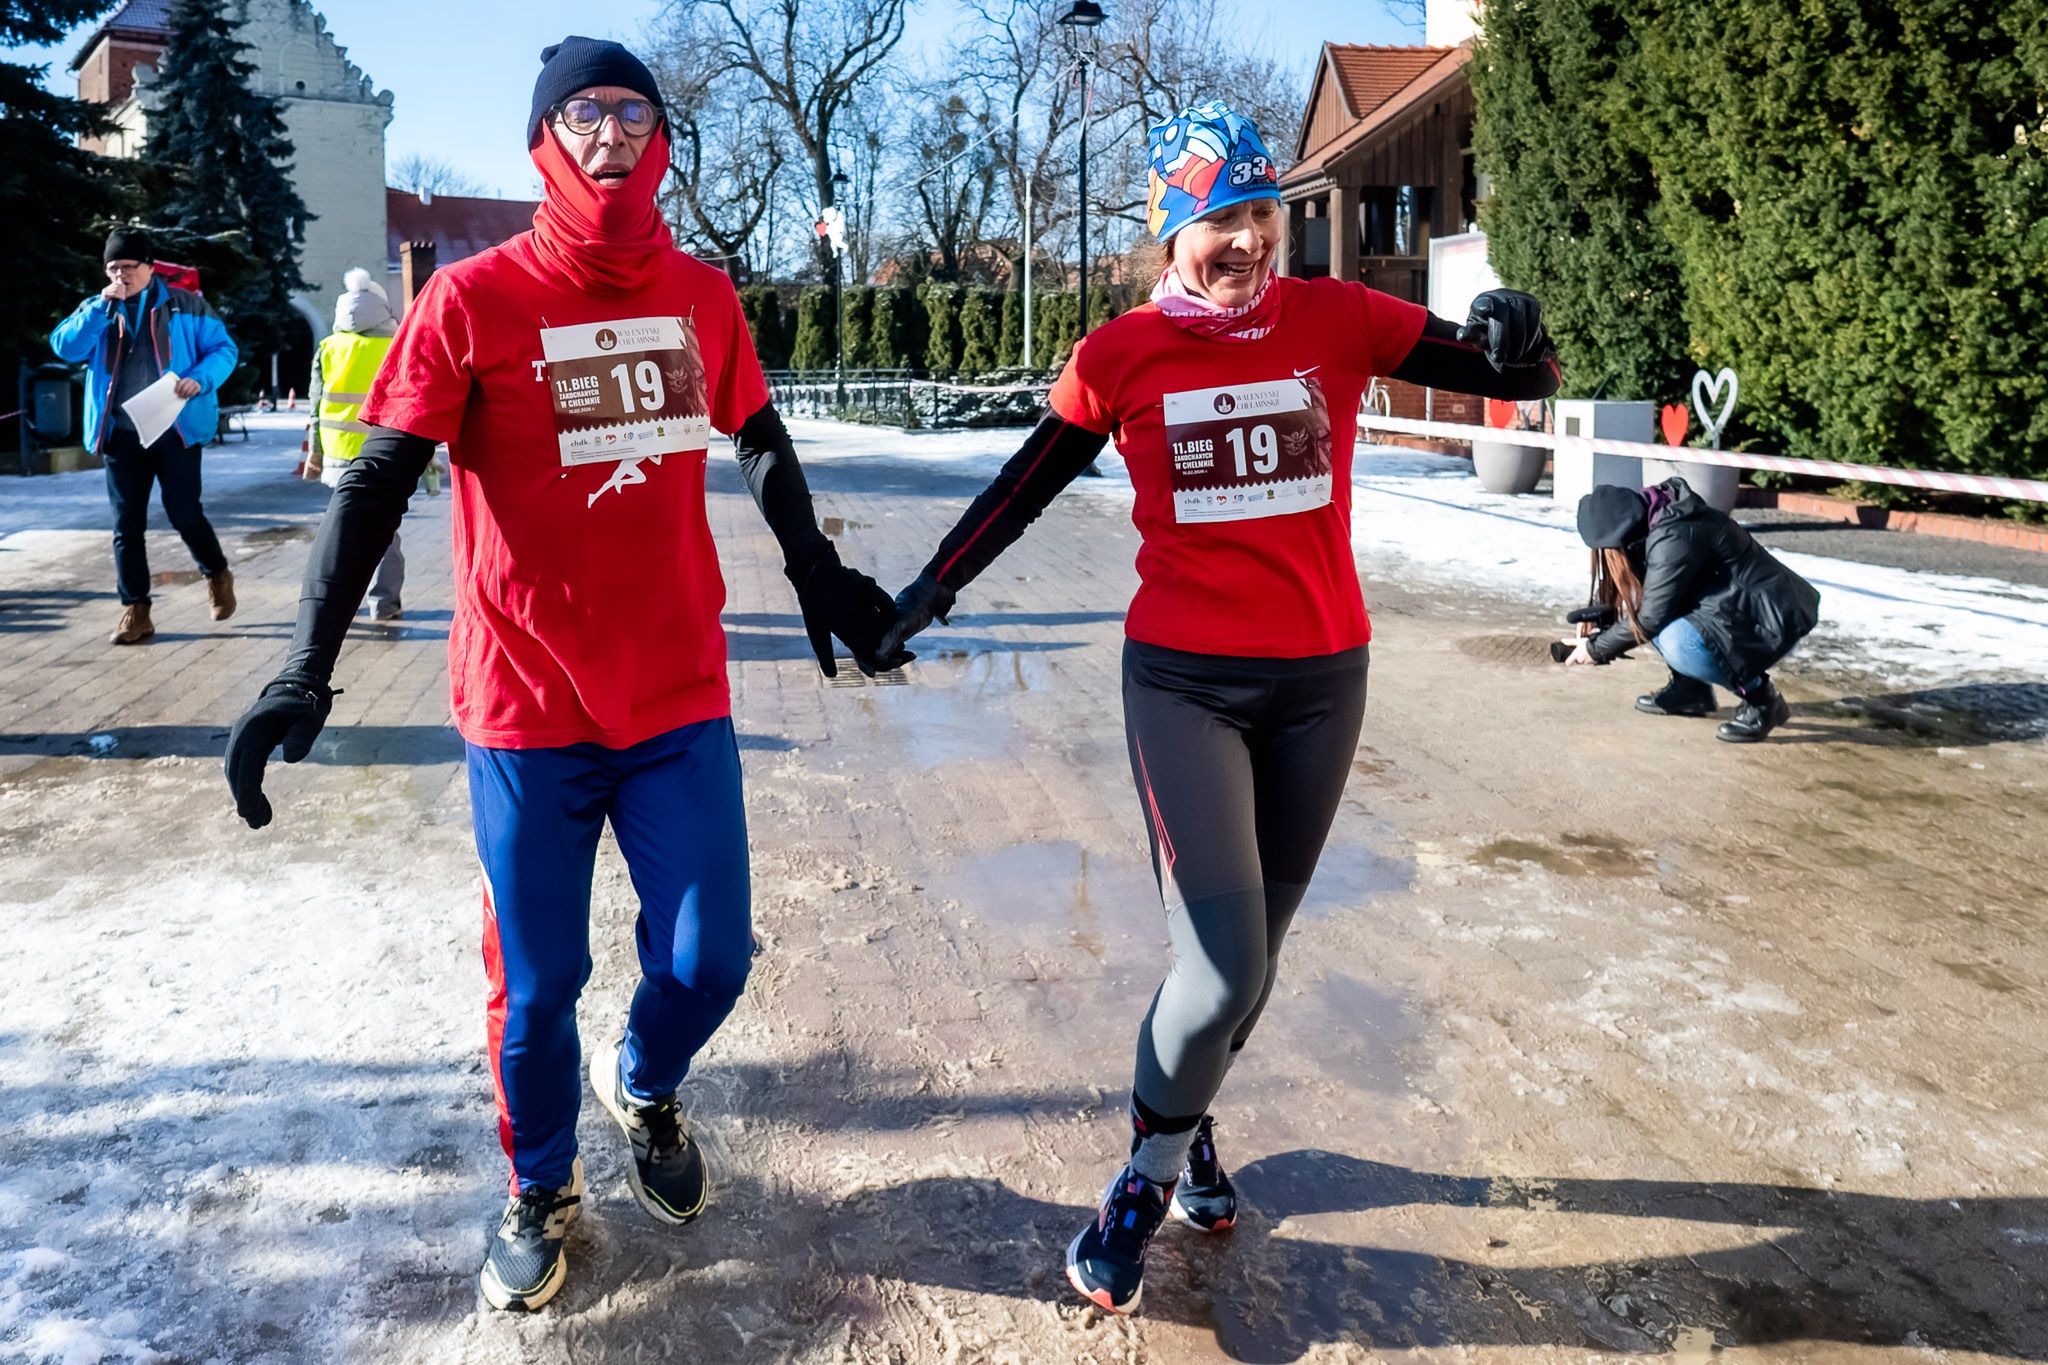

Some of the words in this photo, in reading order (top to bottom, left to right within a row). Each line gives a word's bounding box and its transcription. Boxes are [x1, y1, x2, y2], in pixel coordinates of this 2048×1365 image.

[1231, 155, 1268, 186] 33
[531, 360, 547, 382] T
[559, 388, 600, 400] ZAKOCHANYCH
[610, 359, 666, 414] 19
[560, 399, 567, 409] W
[1174, 452, 1214, 462] ZAKOCHANYCH
[1225, 424, 1279, 478] 19
[1174, 462, 1181, 470] W
